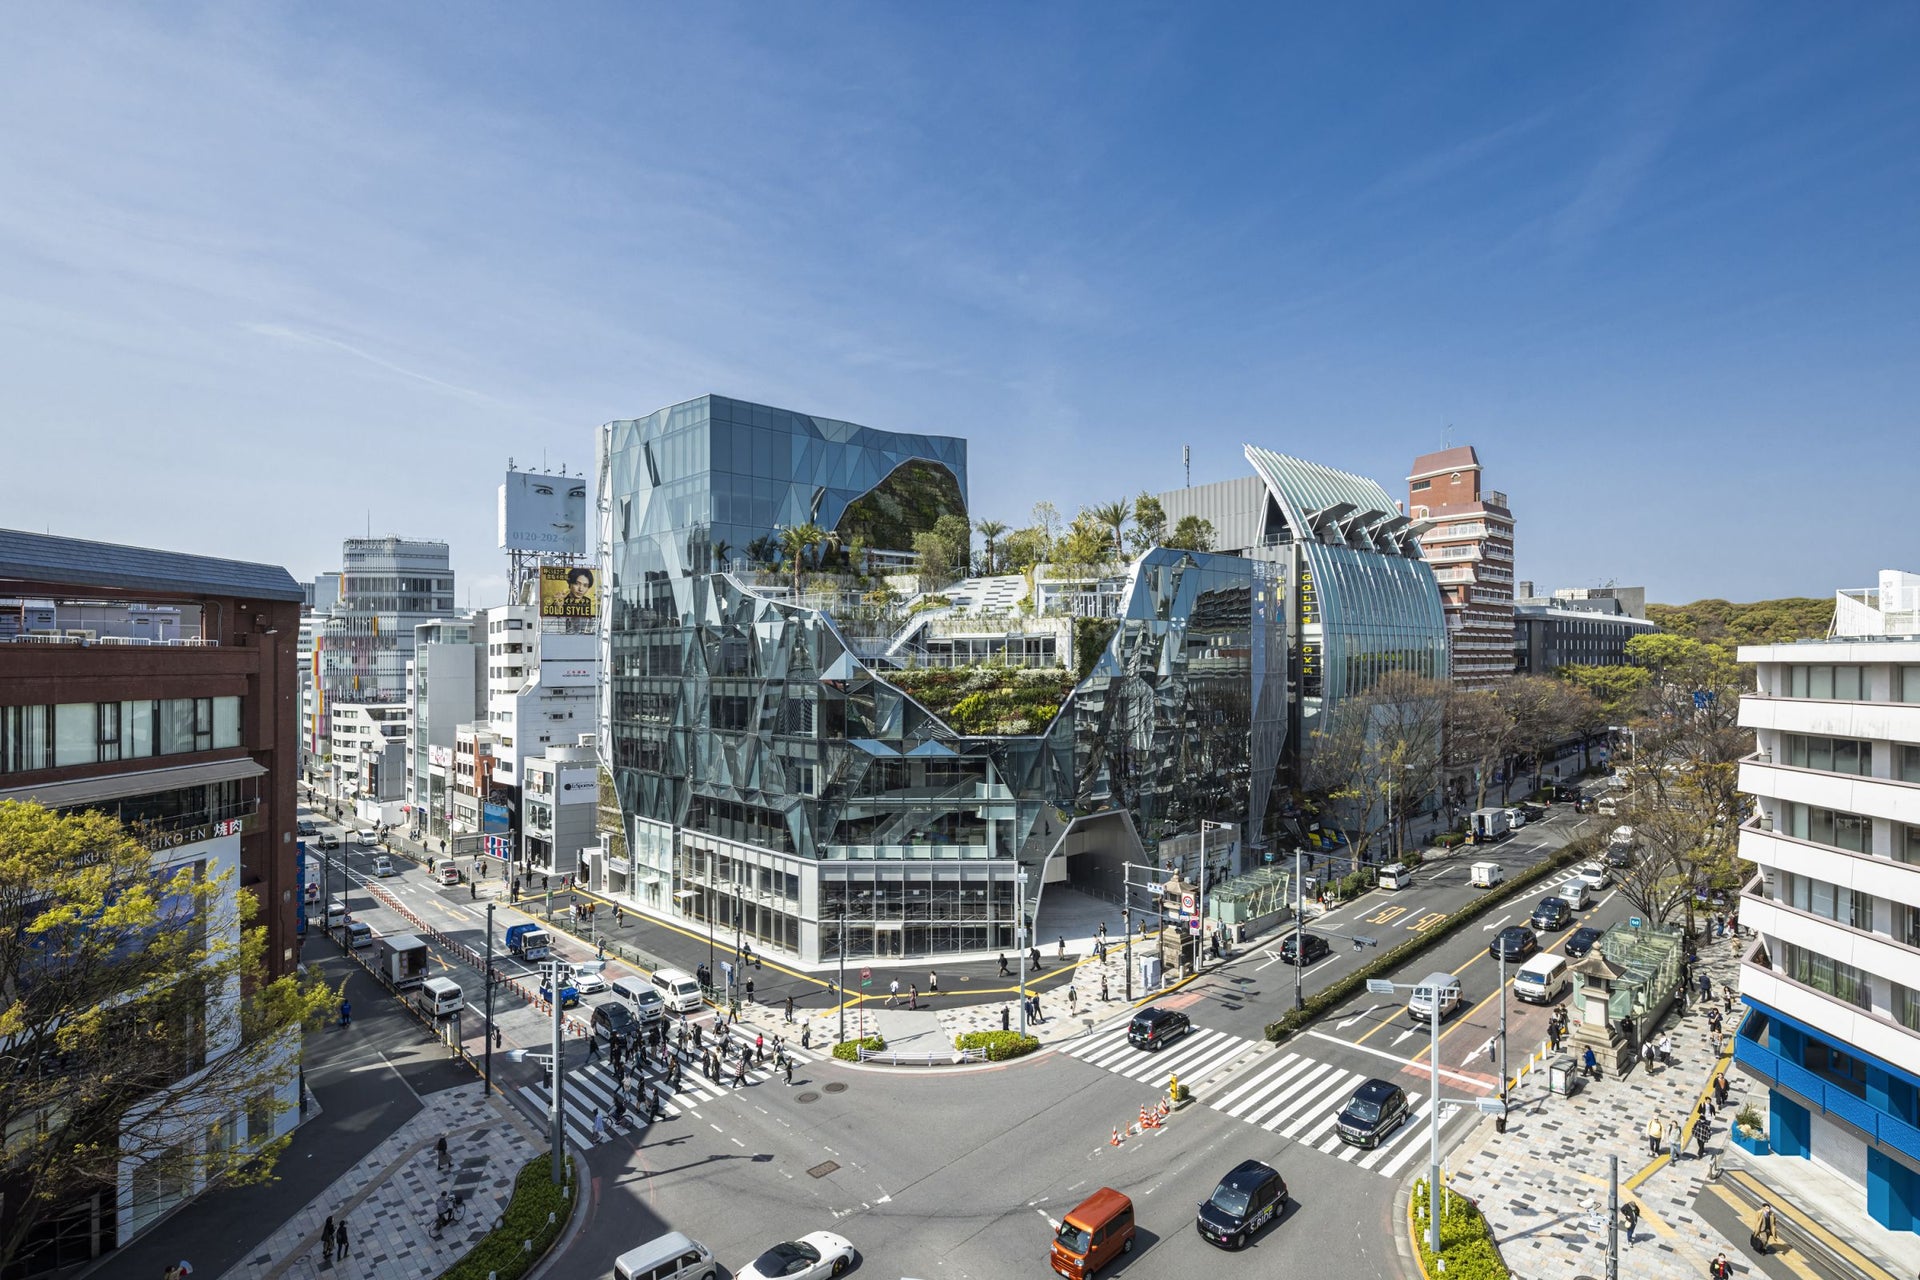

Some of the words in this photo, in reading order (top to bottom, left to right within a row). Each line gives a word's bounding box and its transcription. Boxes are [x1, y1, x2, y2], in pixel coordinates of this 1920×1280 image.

[512, 531, 580, 544] 0120-202-
[543, 605, 564, 615] GOLD
[566, 606, 590, 616] STYLE
[213, 818, 243, 838] 焼肉
[141, 828, 207, 851] SEIKO-EN
[1365, 906, 1408, 925] 50
[1406, 912, 1448, 932] 50
